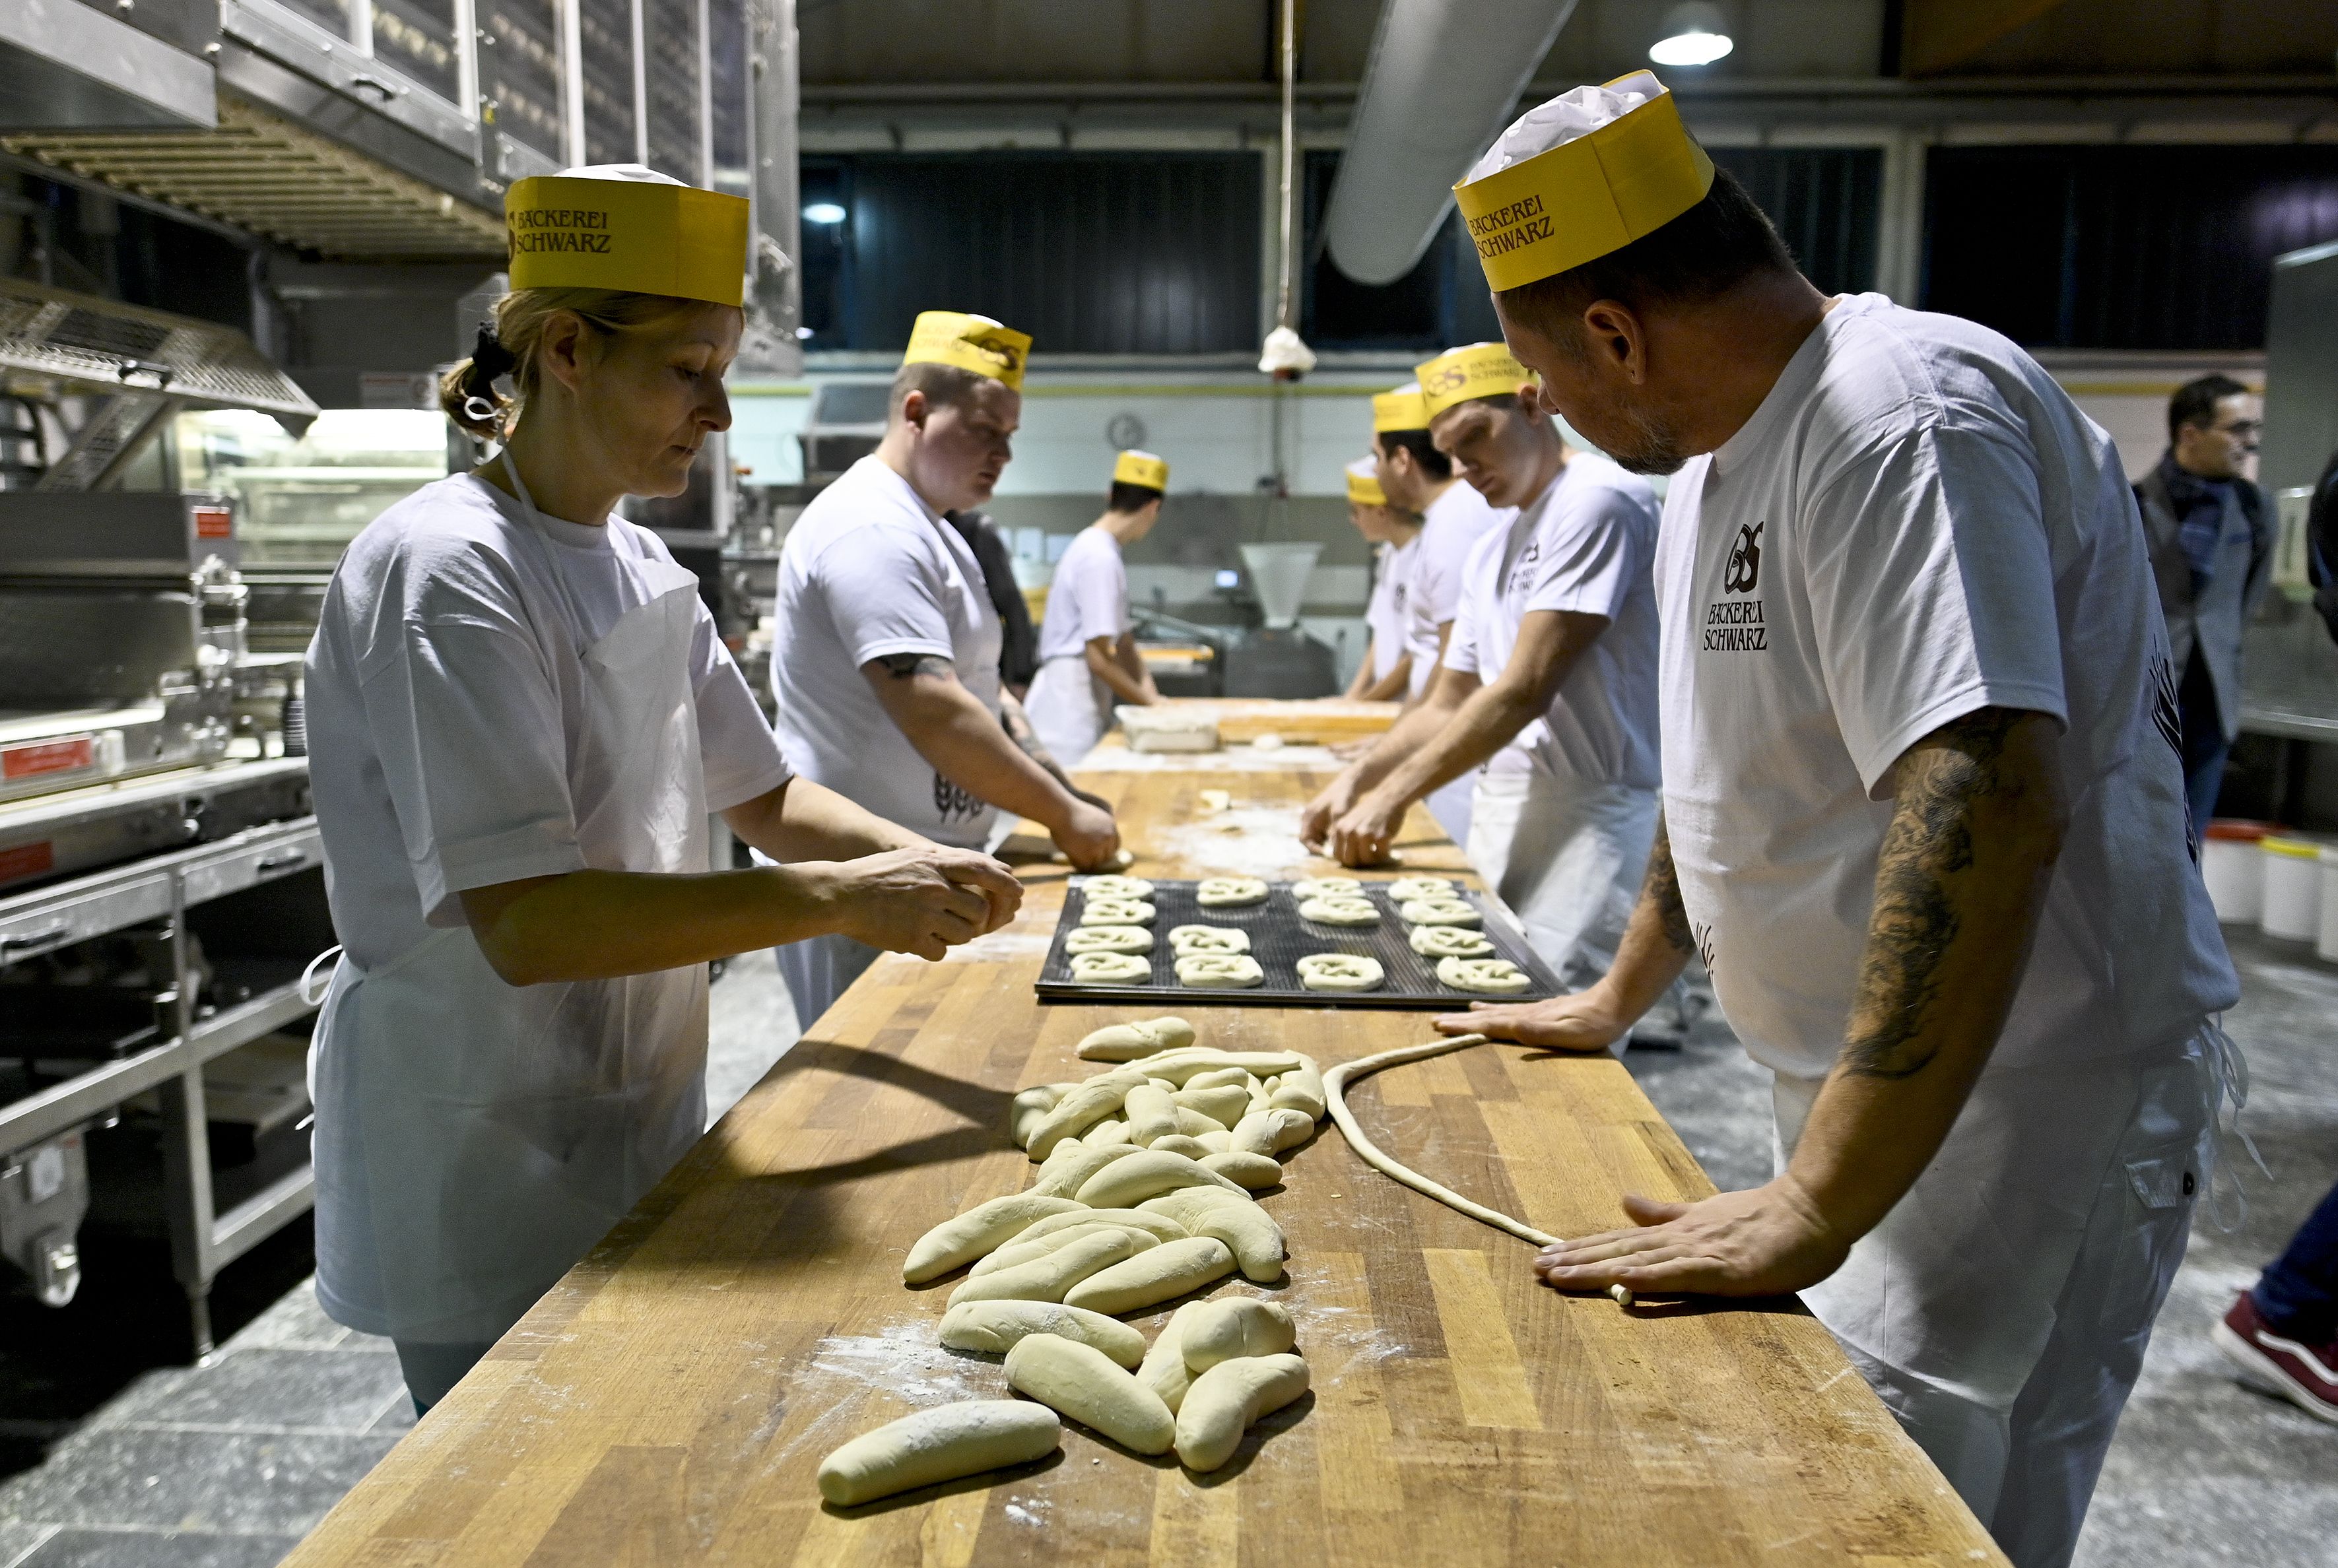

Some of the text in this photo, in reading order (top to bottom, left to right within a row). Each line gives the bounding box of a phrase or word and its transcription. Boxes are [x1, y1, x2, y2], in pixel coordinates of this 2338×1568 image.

[517, 232, 611, 253] SCHWARZ
[1476, 216, 1554, 259] SCHWARZ
[1704, 628, 1768, 651] SCHWARZ
